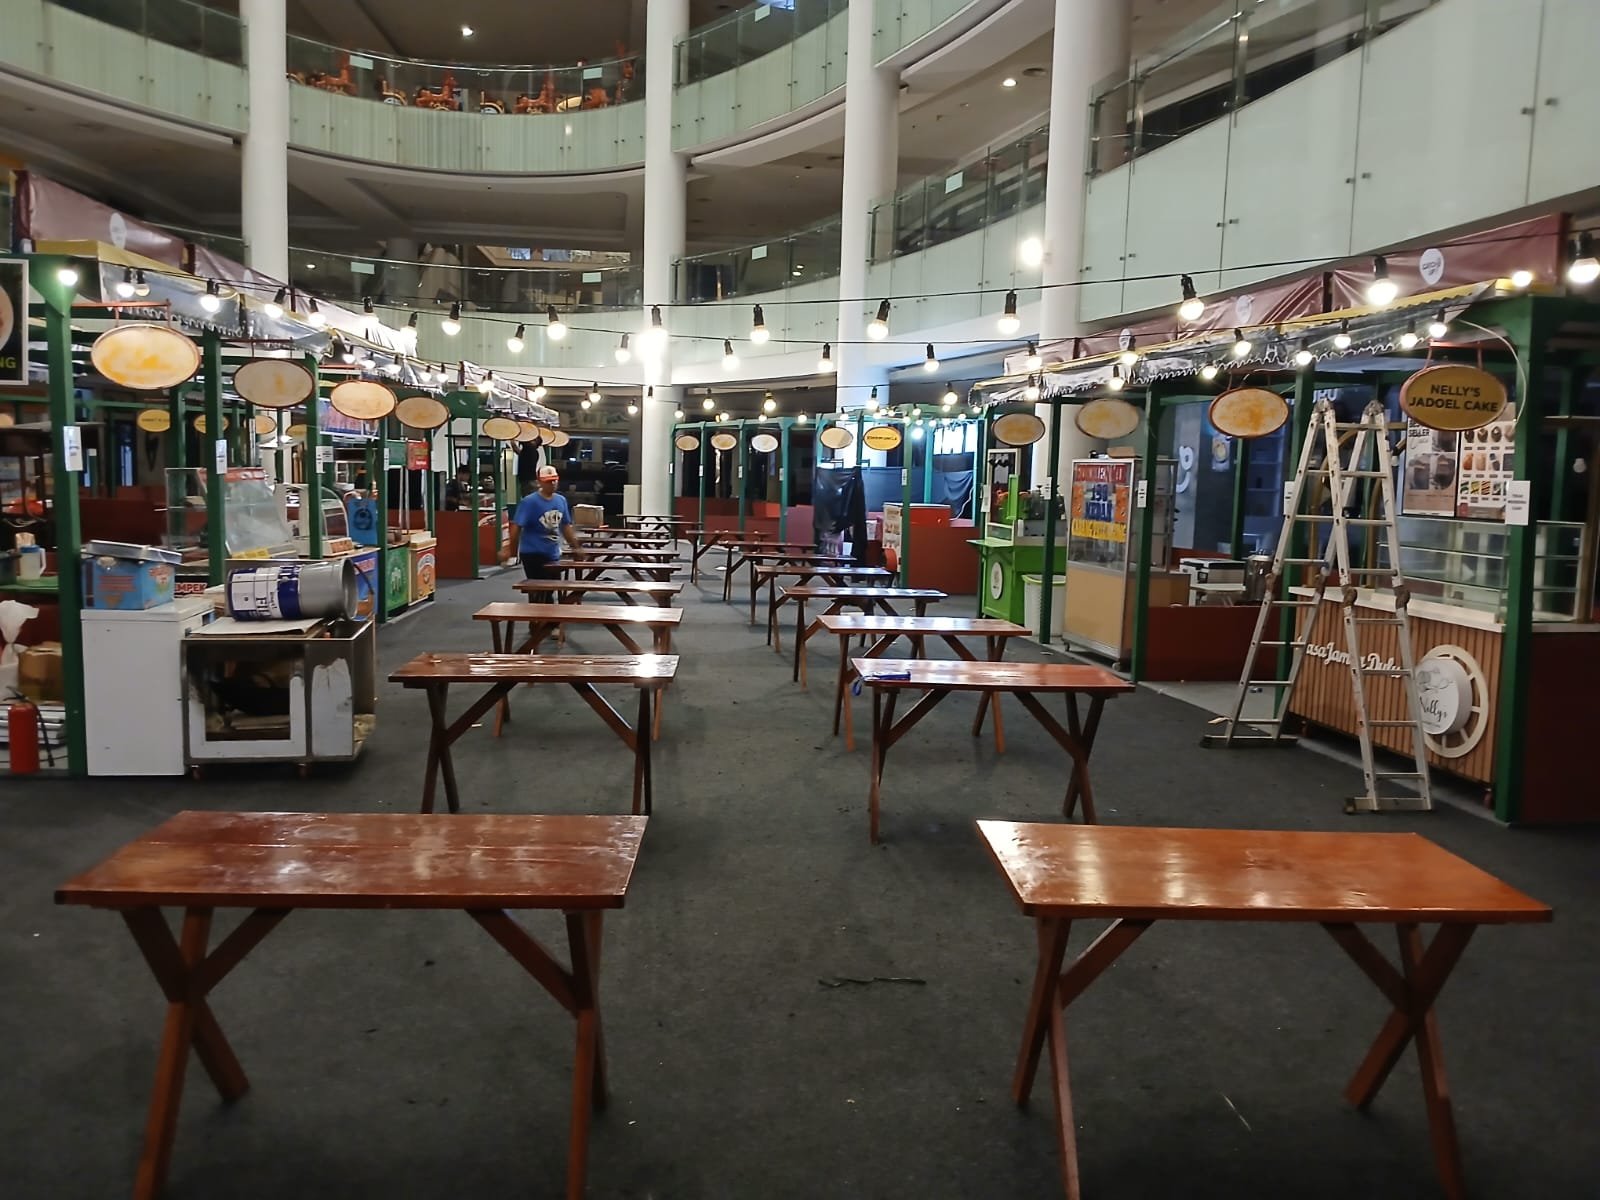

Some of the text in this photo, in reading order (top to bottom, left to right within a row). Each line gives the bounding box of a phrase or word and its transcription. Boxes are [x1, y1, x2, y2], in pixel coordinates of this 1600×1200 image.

[1431, 384, 1481, 397] NELLY'S
[1409, 397, 1499, 412] JADOEL CAKE
